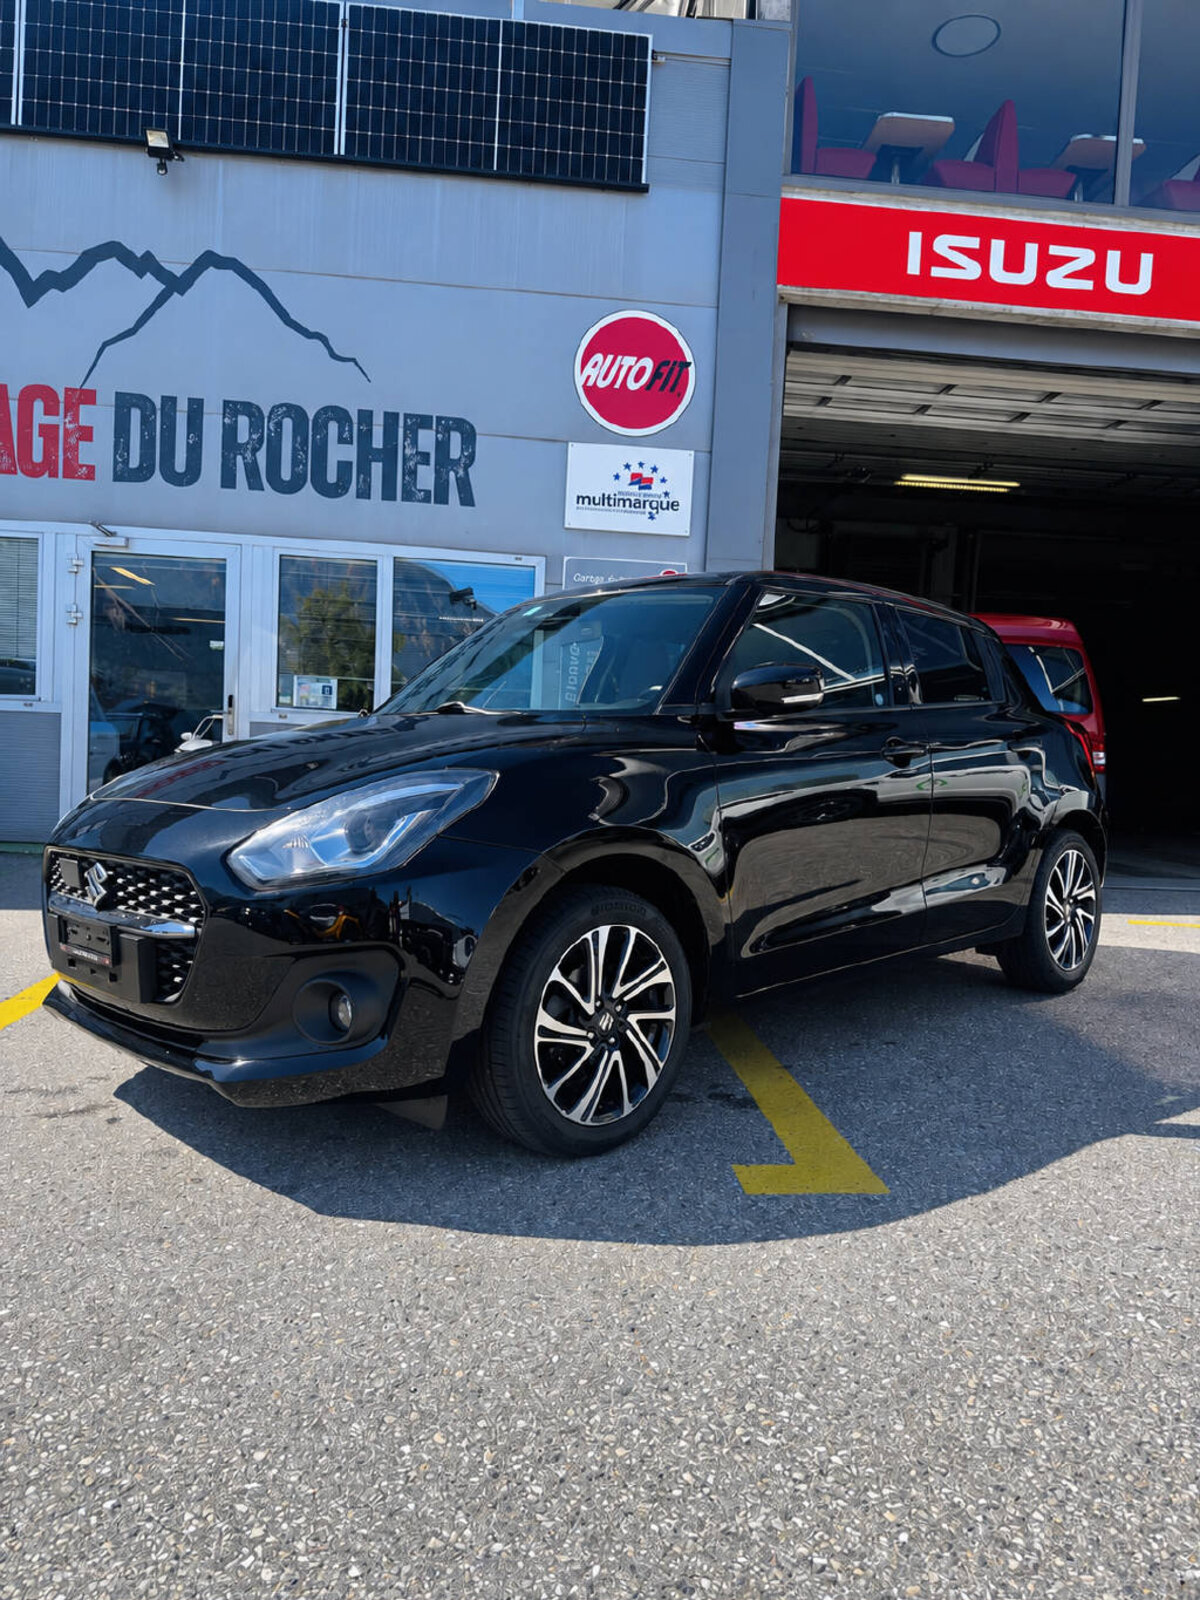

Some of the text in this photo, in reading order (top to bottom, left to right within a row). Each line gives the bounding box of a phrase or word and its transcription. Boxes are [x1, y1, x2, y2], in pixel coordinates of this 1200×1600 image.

[907, 231, 1154, 296] ISUZU
[112, 391, 205, 487] DU
[220, 399, 477, 507] ROCHER
[576, 493, 680, 514] multimarque
